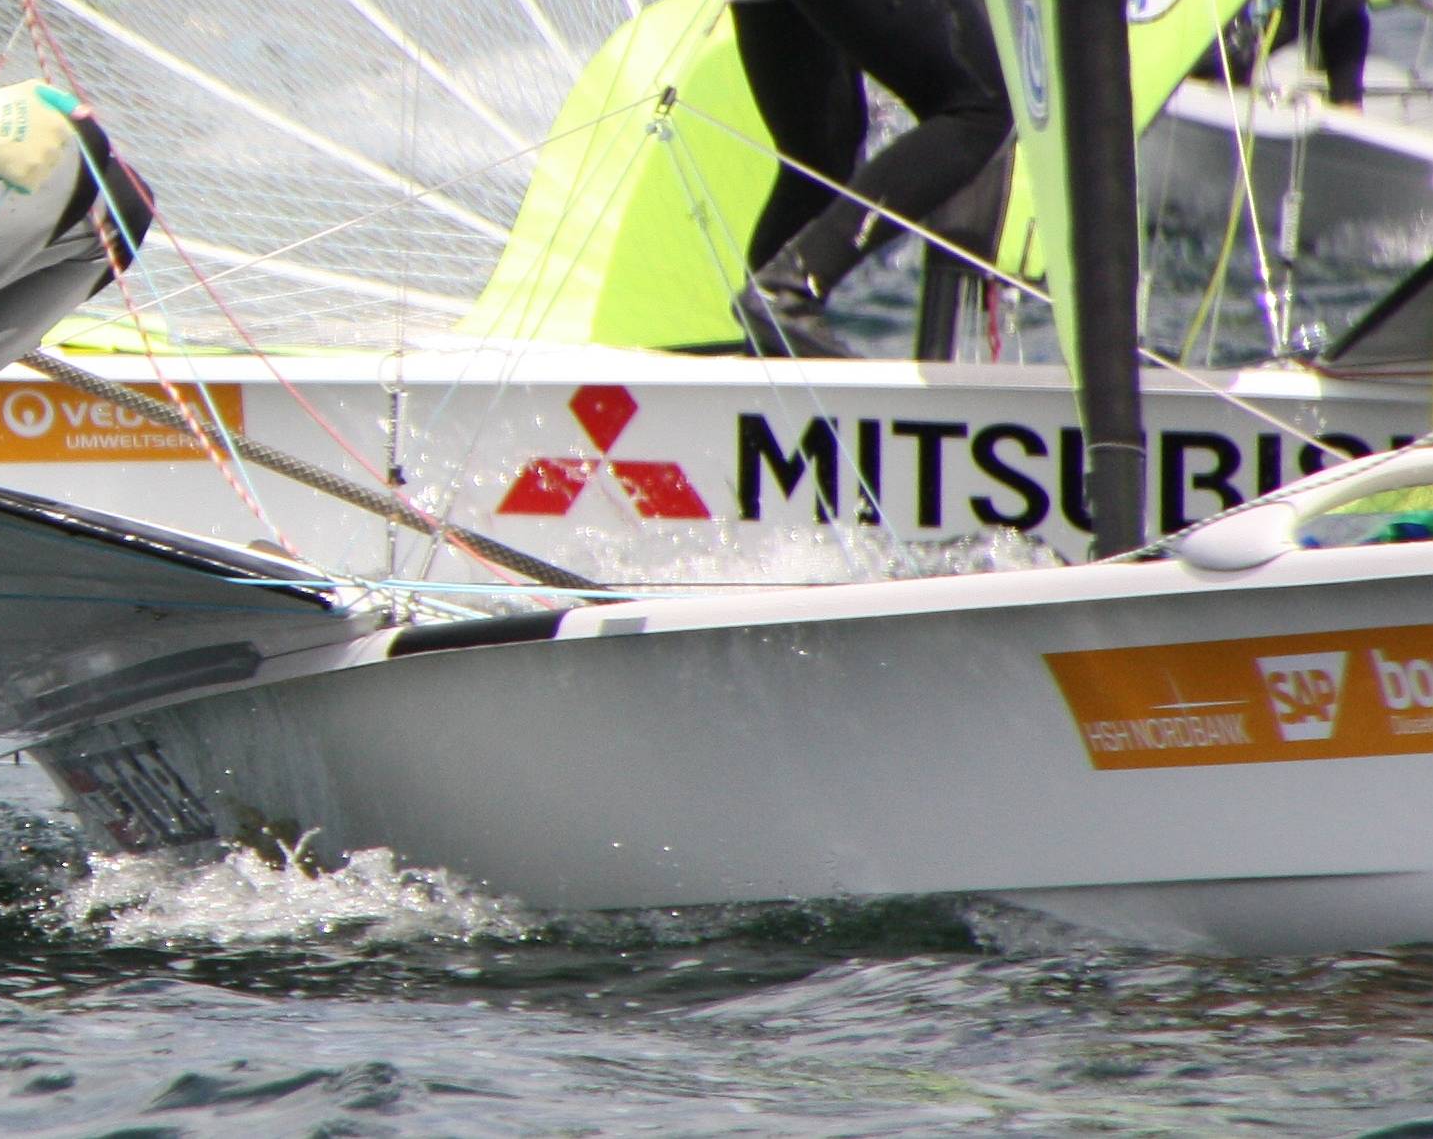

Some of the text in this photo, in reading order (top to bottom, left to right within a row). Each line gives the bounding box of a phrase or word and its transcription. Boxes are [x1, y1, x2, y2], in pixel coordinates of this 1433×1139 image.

[66, 433, 206, 449] UMWELTSER
[1264, 668, 1338, 726] SAP
[1131, 714, 1255, 750] NORDBANK
